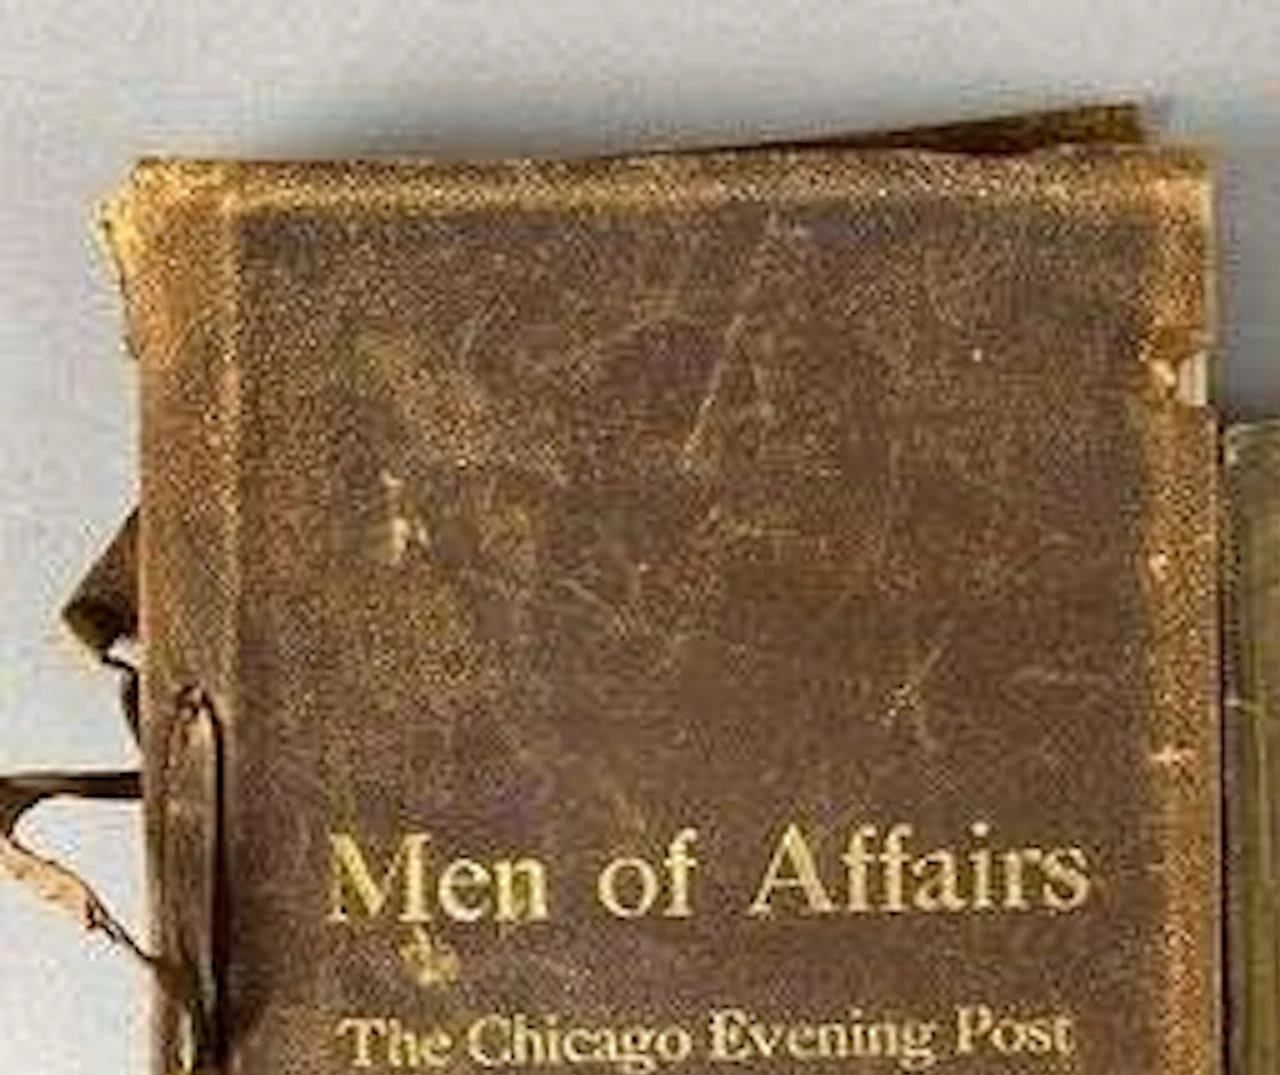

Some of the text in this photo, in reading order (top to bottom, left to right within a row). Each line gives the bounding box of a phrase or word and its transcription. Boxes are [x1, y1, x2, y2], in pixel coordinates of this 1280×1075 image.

[326, 821, 1093, 924] Men of Affairs
[333, 1014, 454, 1071] The
[708, 1005, 937, 1072] Evening
[954, 1003, 1078, 1060] Post
